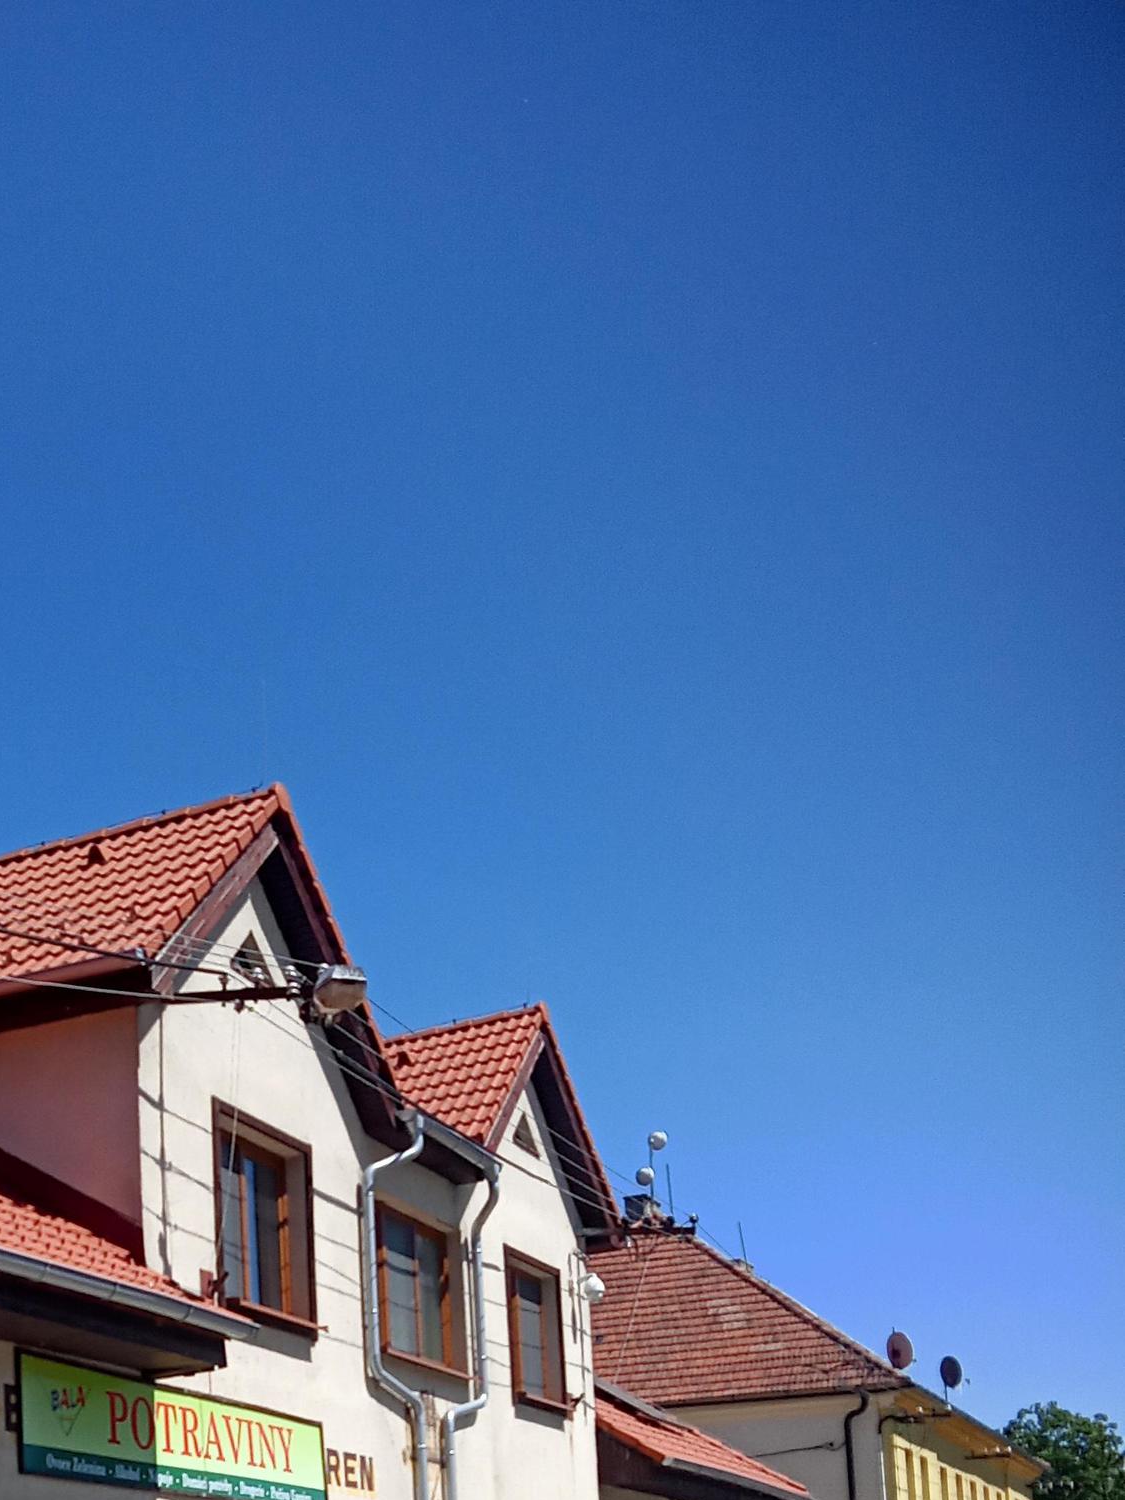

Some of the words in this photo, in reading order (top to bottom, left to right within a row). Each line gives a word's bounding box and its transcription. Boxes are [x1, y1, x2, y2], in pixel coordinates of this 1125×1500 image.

[51, 1385, 86, 1411] BALA
[106, 1391, 293, 1473] POTRAVINY
[326, 1447, 374, 1491] REN
